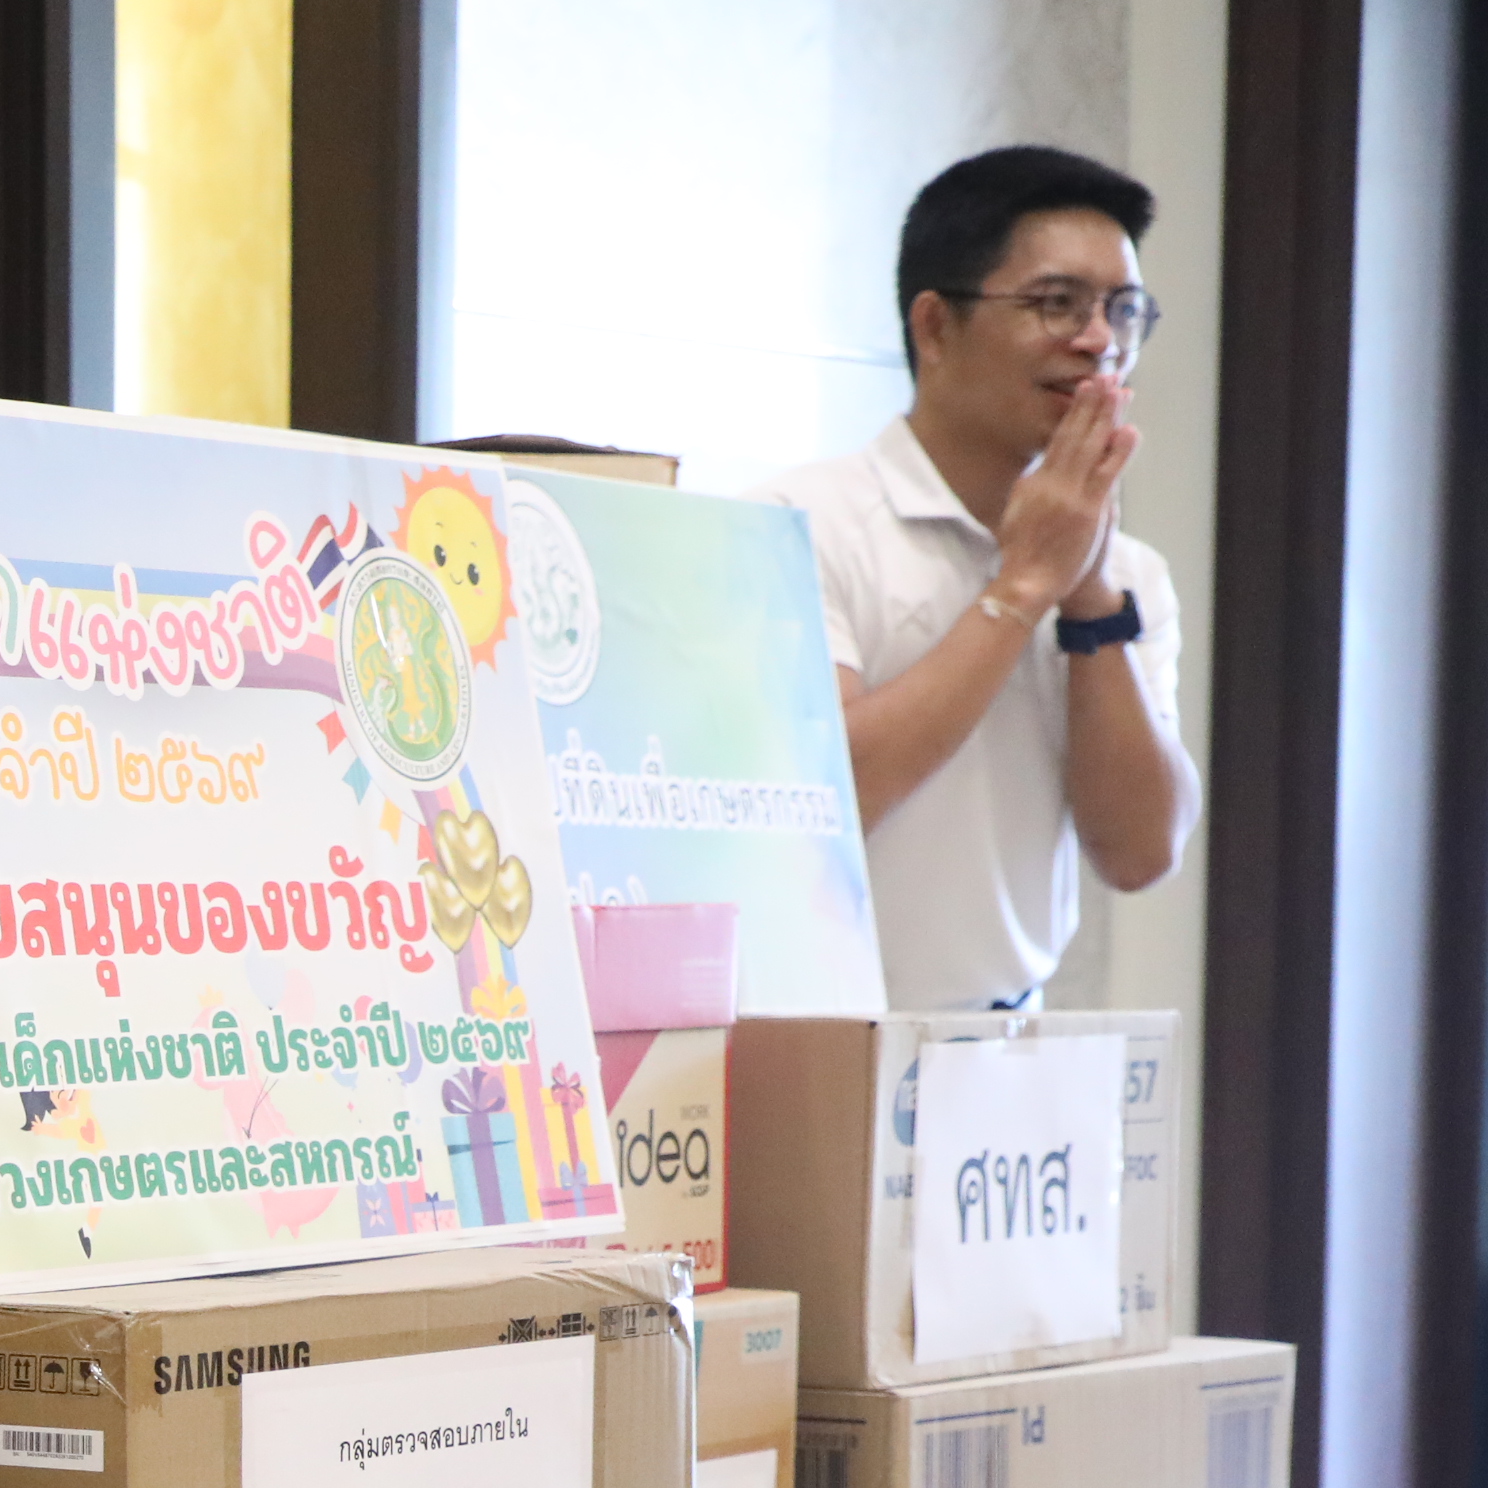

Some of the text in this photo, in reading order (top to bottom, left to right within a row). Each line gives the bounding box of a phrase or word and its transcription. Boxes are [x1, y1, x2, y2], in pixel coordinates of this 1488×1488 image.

[116, 738, 265, 805] ๒๕๖๙
[259, 1003, 408, 1079] ประจำปี
[419, 1018, 531, 1066] ๒๕๖๙
[616, 1108, 710, 1190] idea
[956, 1143, 1087, 1244] ศทส.
[338, 1406, 529, 1472] กลุ่มตรวจสอบภายใน
